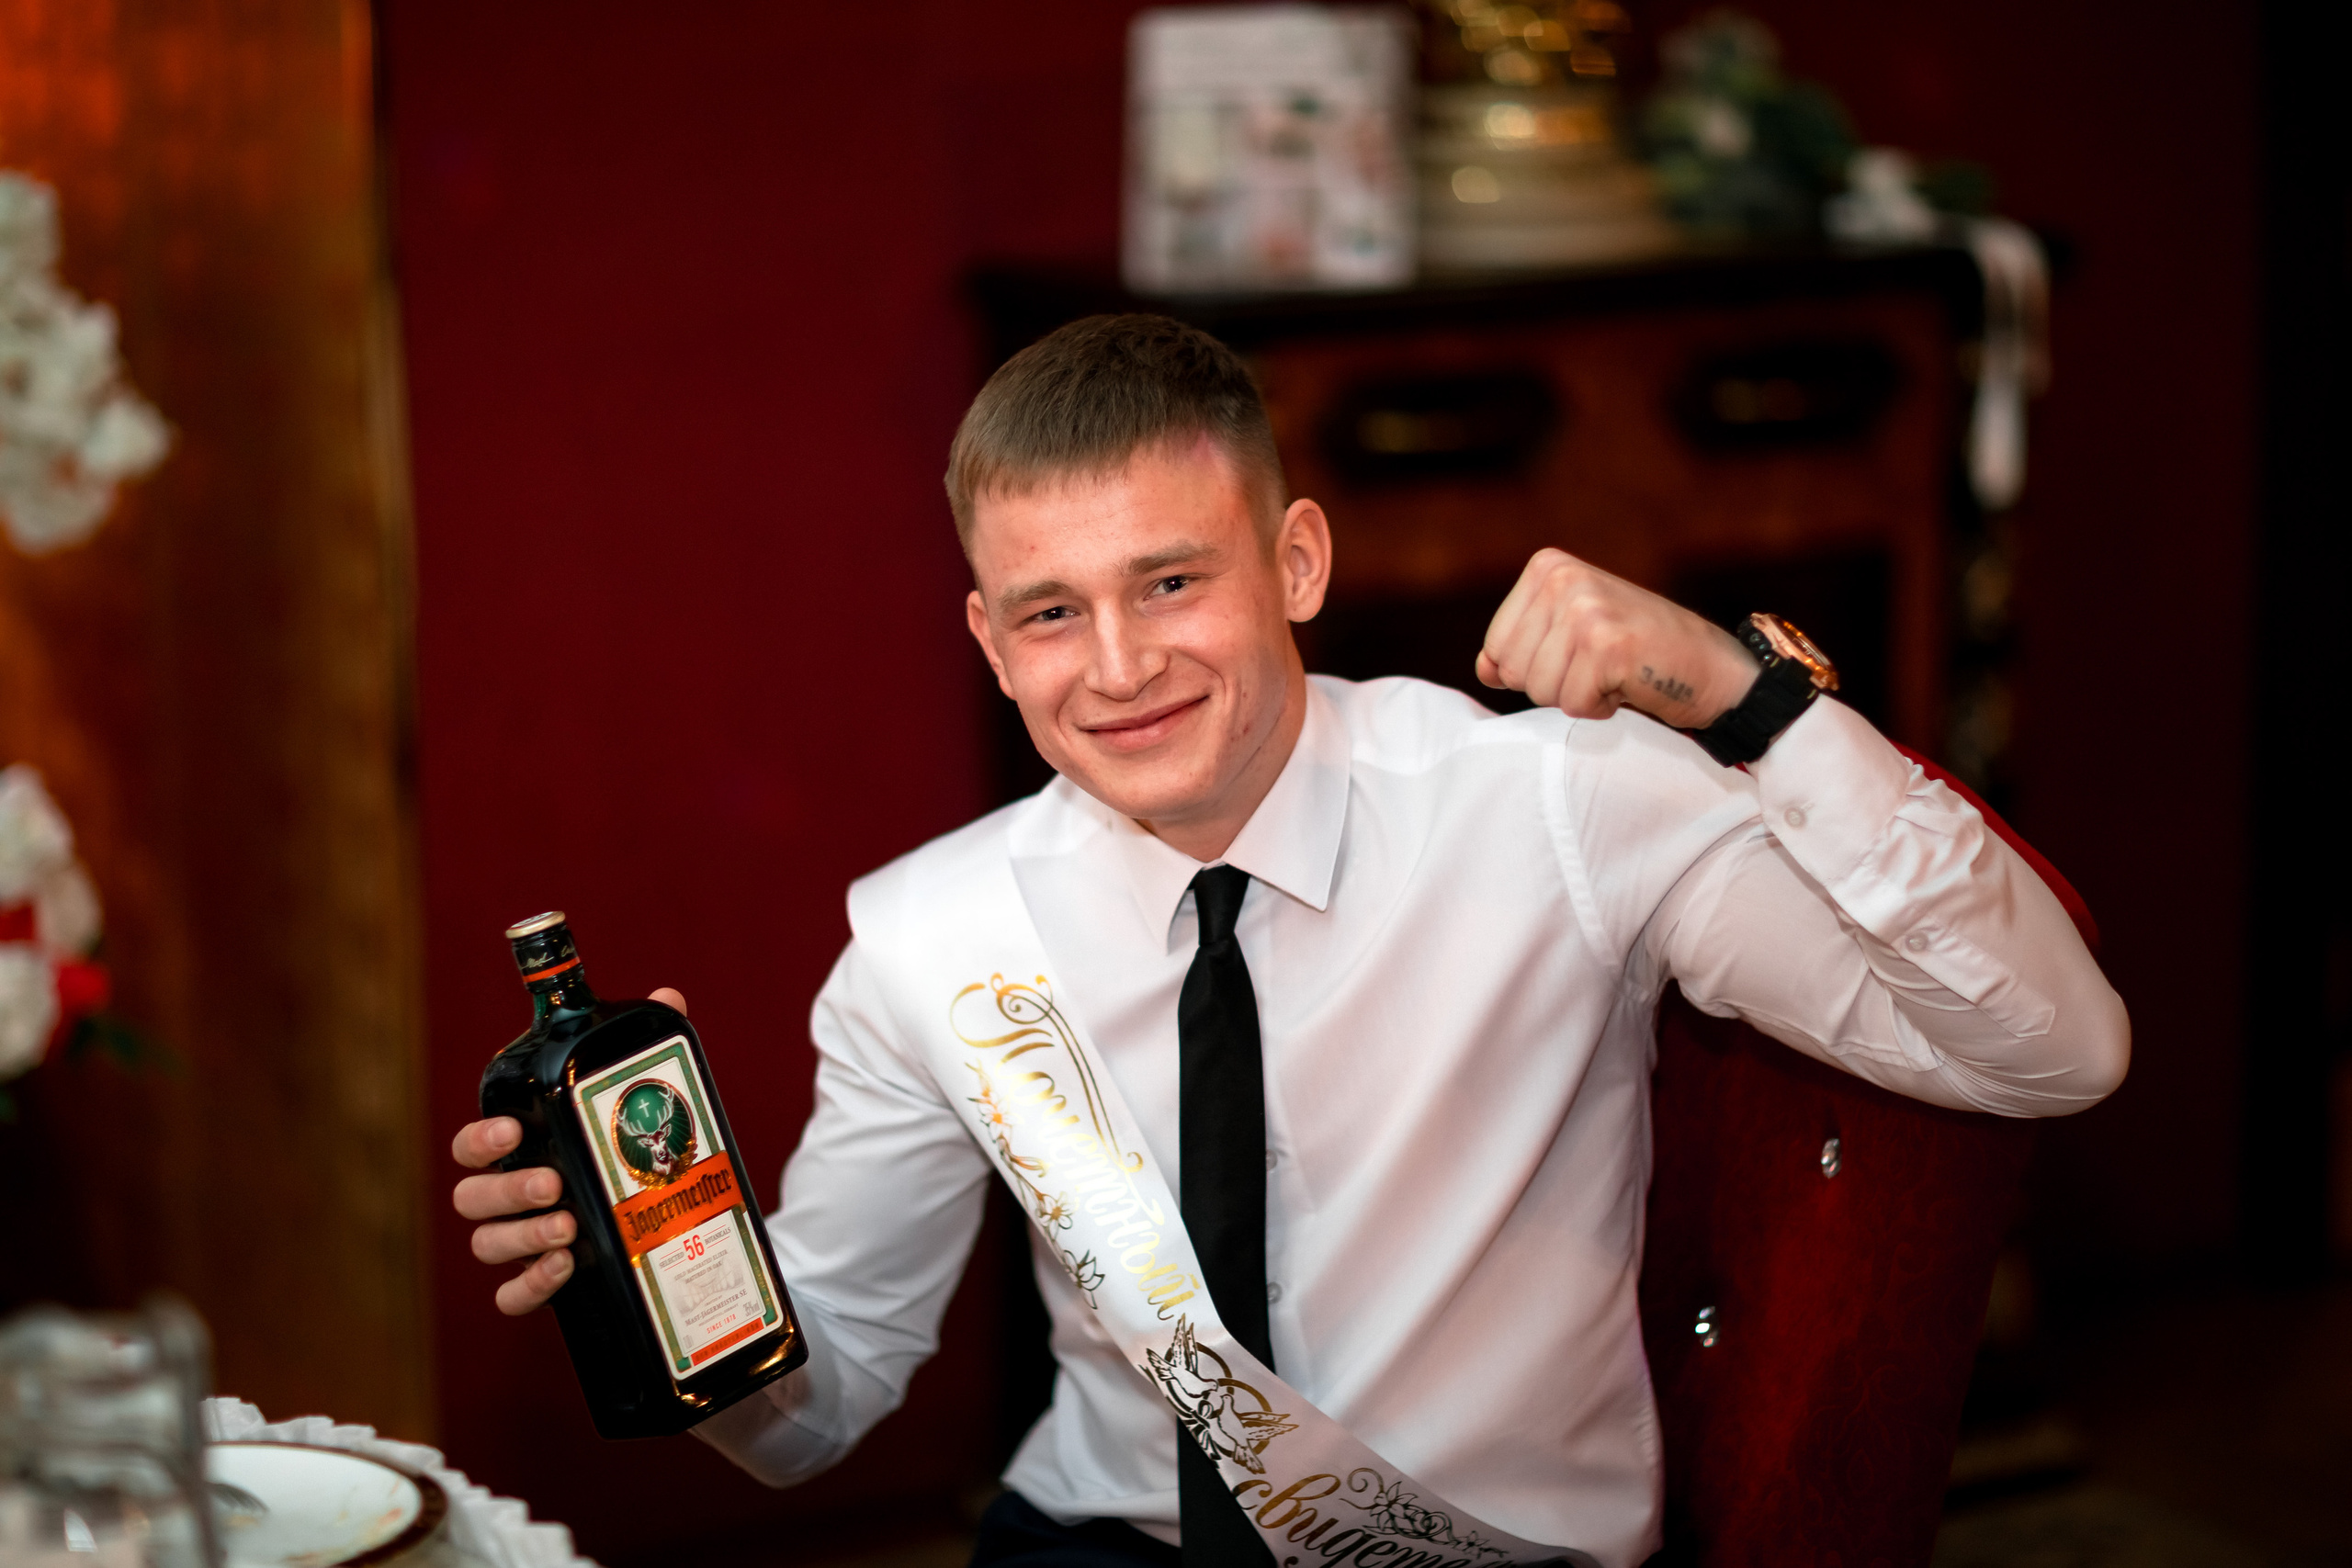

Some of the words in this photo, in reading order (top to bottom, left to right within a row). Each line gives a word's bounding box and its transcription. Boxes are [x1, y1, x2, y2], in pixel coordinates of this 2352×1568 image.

[659, 1251, 685, 1269] SELECTED
[683, 1235, 705, 1260] 56
[704, 1227, 731, 1245] BOTANICALS
[739, 1289, 748, 1298] SE
[707, 1321, 723, 1334] SINCE
[724, 1314, 737, 1325] 1878
